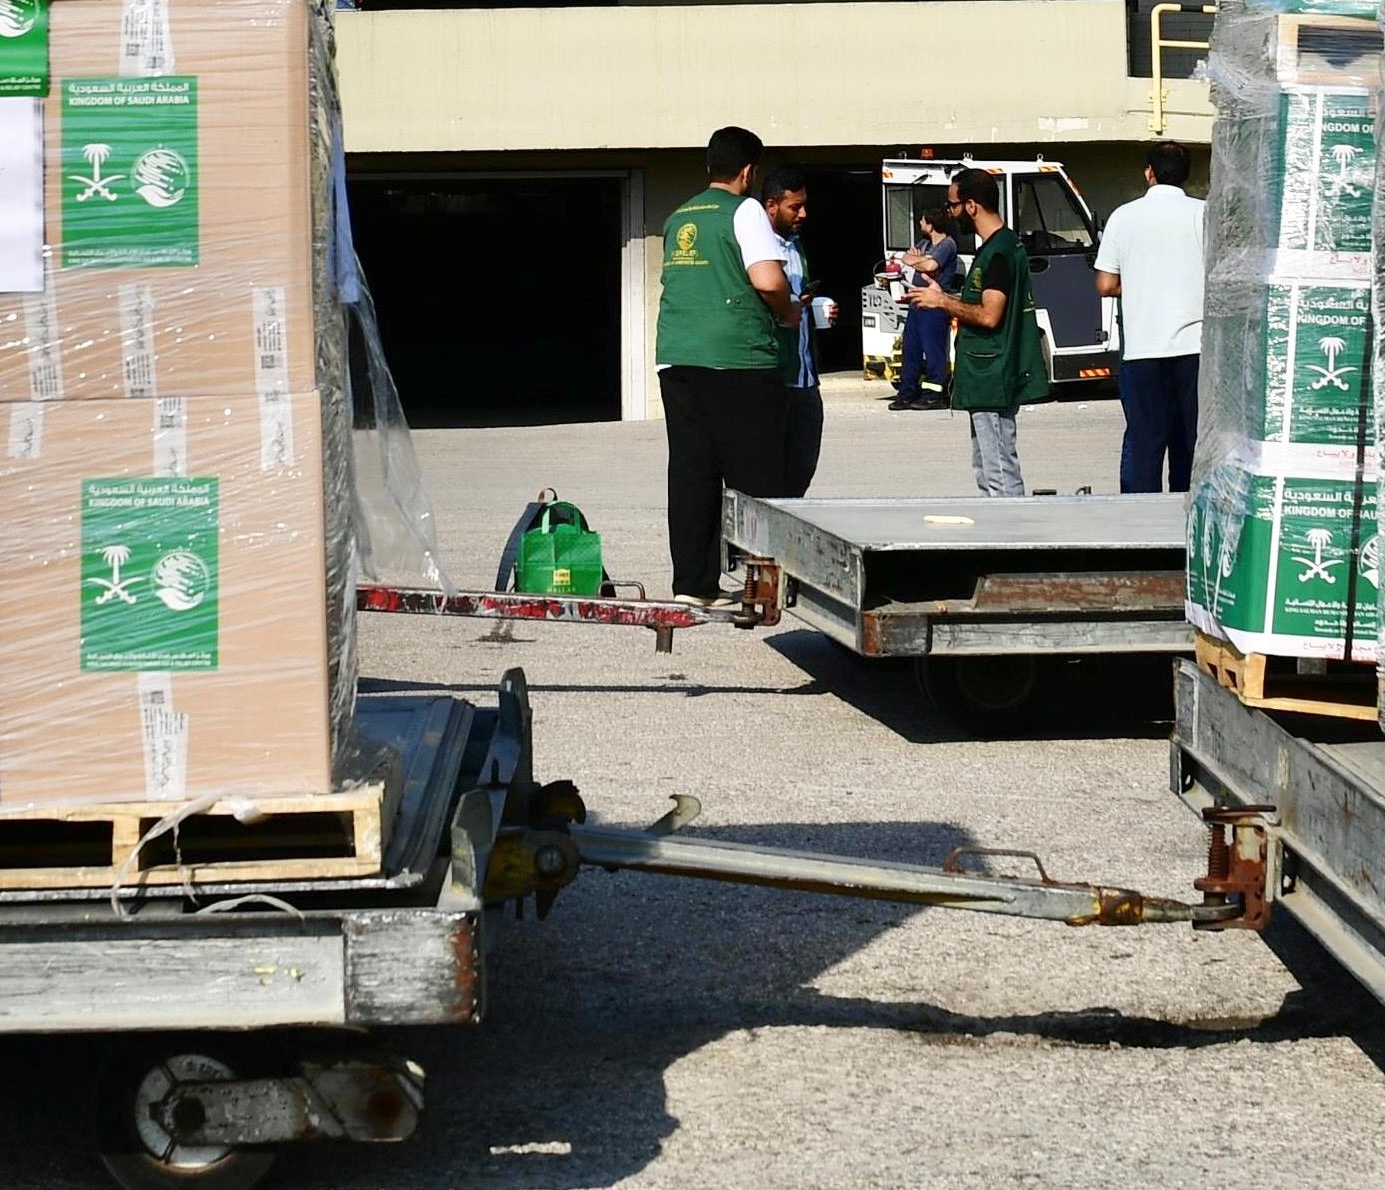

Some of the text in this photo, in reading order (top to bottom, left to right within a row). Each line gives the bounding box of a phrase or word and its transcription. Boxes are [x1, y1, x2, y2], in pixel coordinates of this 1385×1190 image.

[116, 82, 150, 95] العربية
[151, 82, 189, 92] المملكة
[69, 96, 189, 106] KINGDOM OF SAUDI ARABIA
[1297, 314, 1366, 326] KINGDOM OF
[1284, 505, 1353, 519] KINGDOM OF
